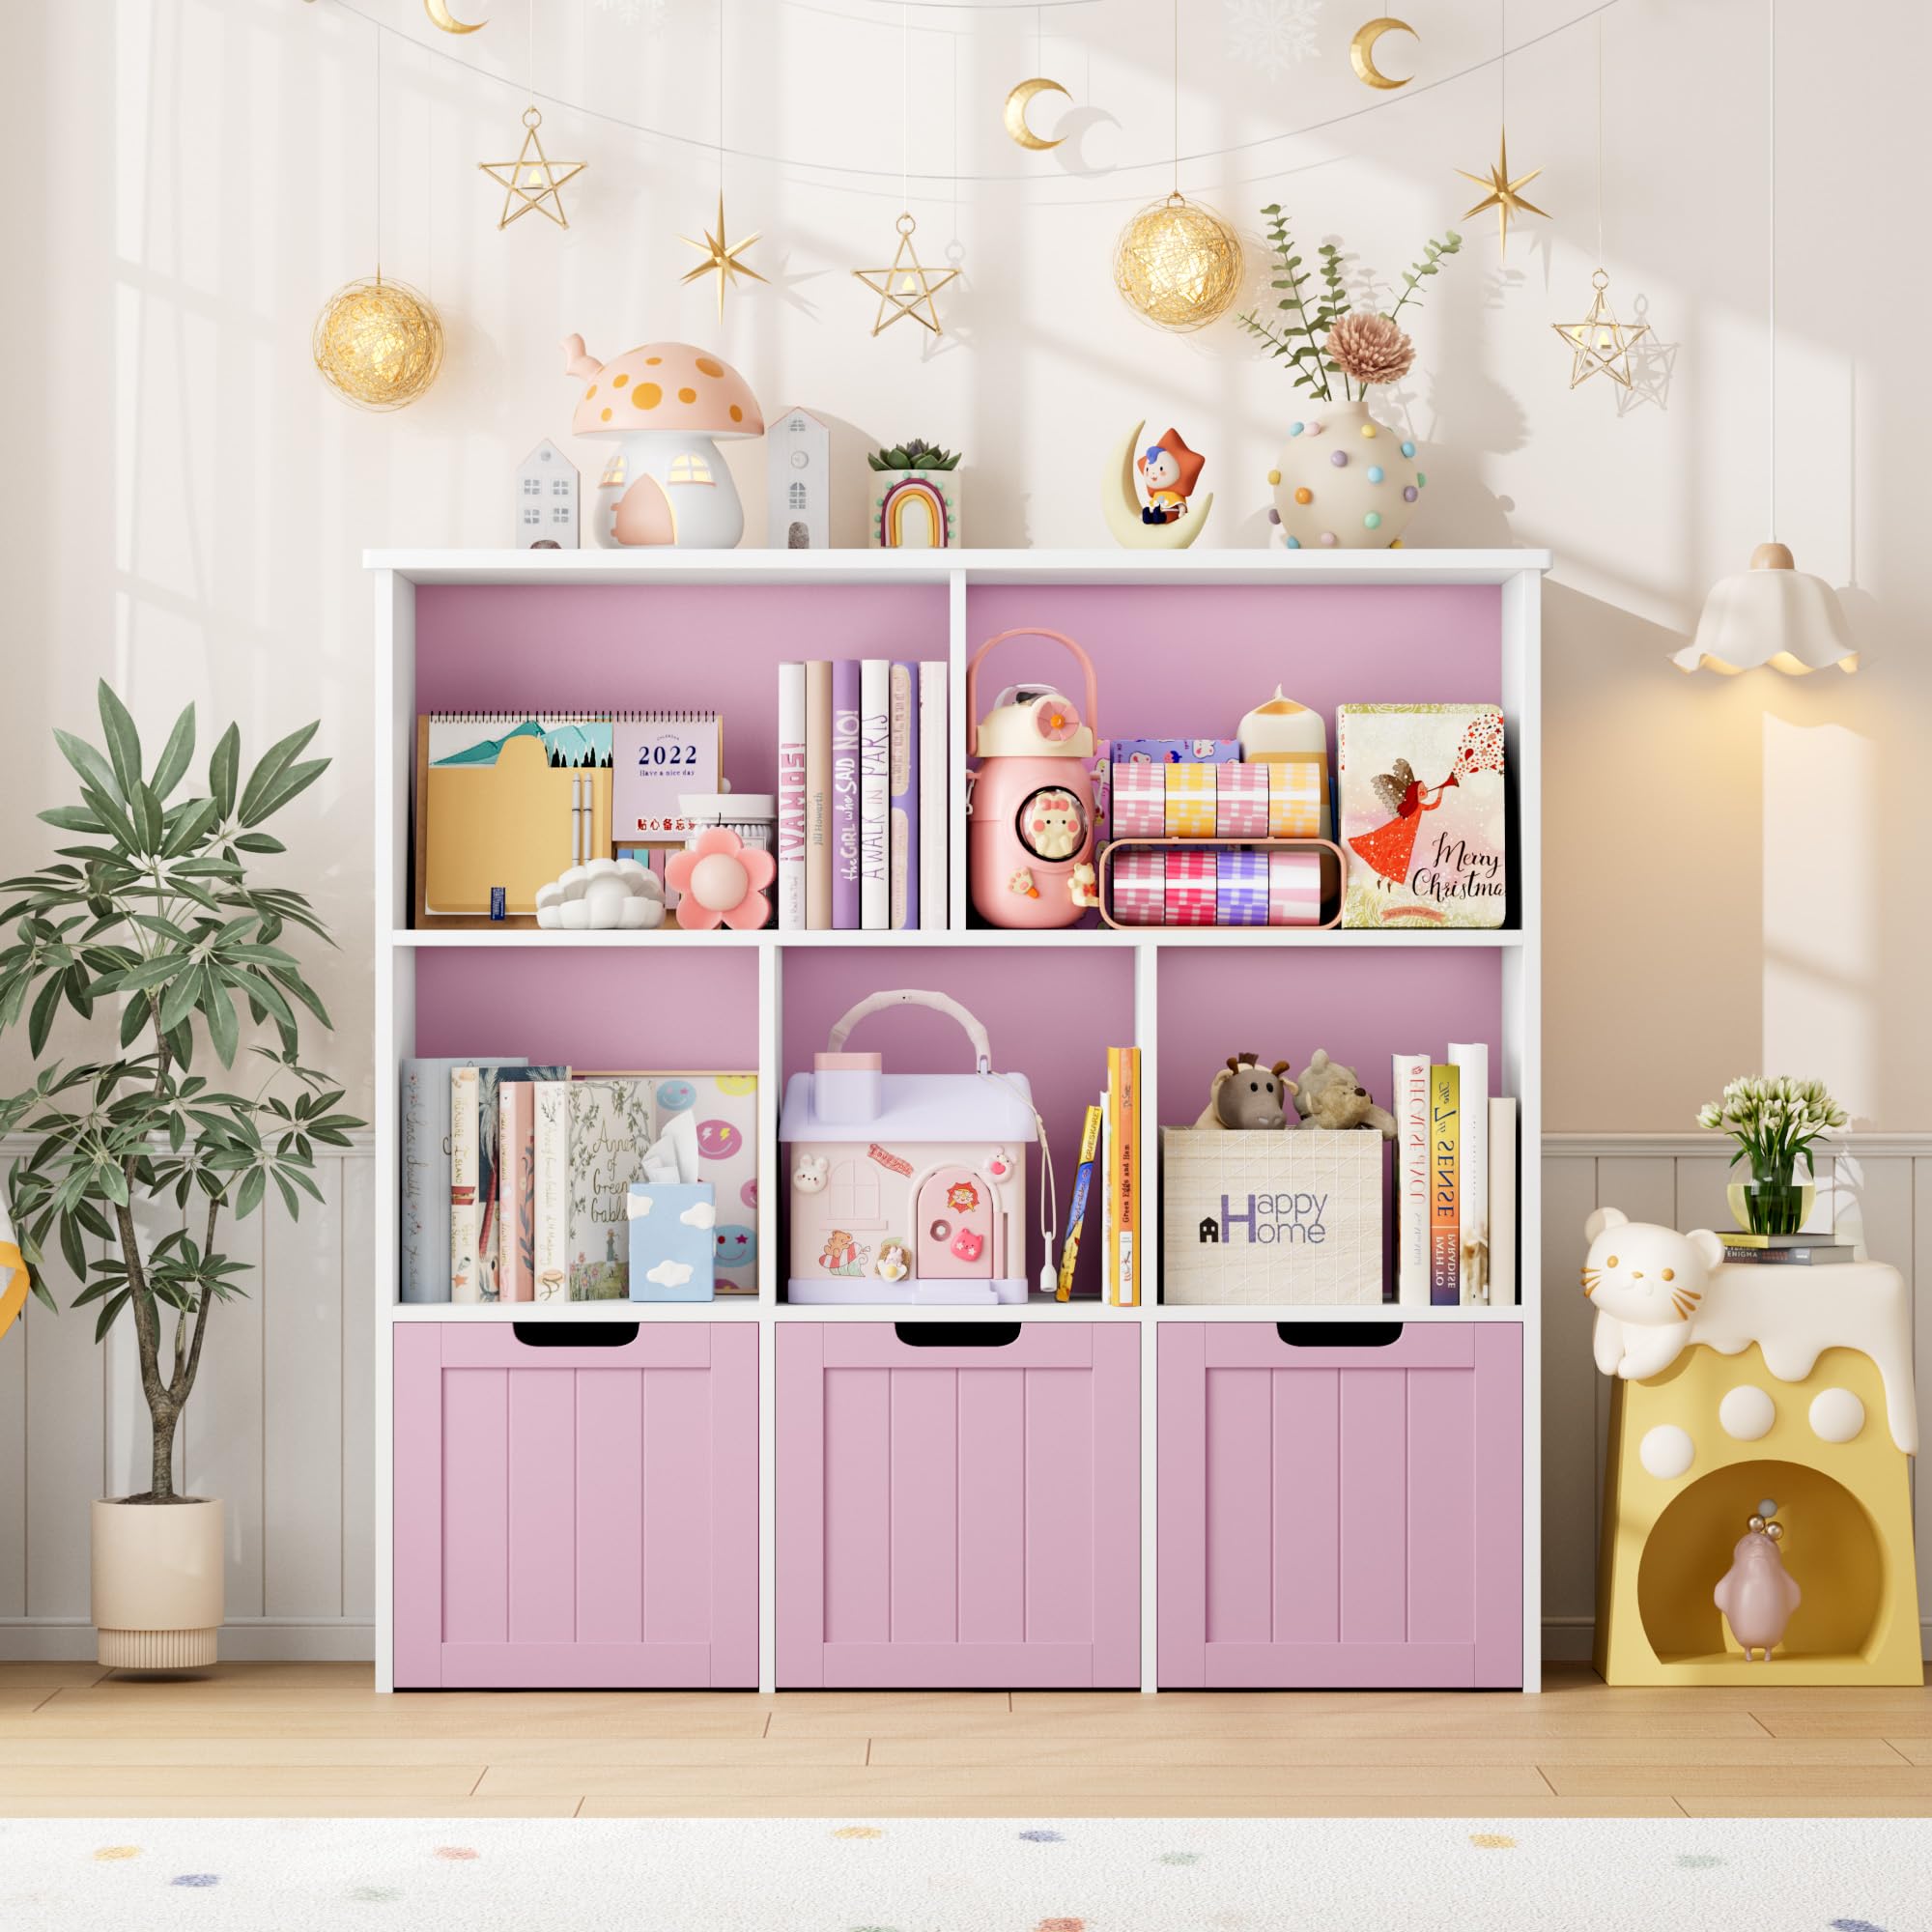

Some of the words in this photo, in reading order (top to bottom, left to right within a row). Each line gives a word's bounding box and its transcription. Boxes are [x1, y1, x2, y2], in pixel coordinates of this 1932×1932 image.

[833, 710, 859, 751] NO!
[862, 714, 890, 777] PARIS
[639, 745, 696, 765] 2022
[682, 769, 695, 778] day
[836, 757, 858, 795] SAID
[813, 792, 824, 832] Howarth
[836, 793, 853, 821] who
[867, 789, 883, 805] IN
[813, 834, 823, 845] Jill
[839, 823, 858, 859] GIRL
[862, 814, 885, 867] WALK
[1432, 832, 1503, 879] Merry
[841, 858, 858, 881] the
[863, 867, 885, 880] A
[1412, 867, 1506, 903] Christma
[454, 1097, 465, 1138] TREASURE
[593, 1118, 631, 1153] Anne
[454, 1146, 465, 1184] ISLAND
[607, 1151, 617, 1181] of
[593, 1168, 629, 1195] Green
[1122, 1182, 1131, 1198] Eggs
[591, 1197, 629, 1223] Gable
